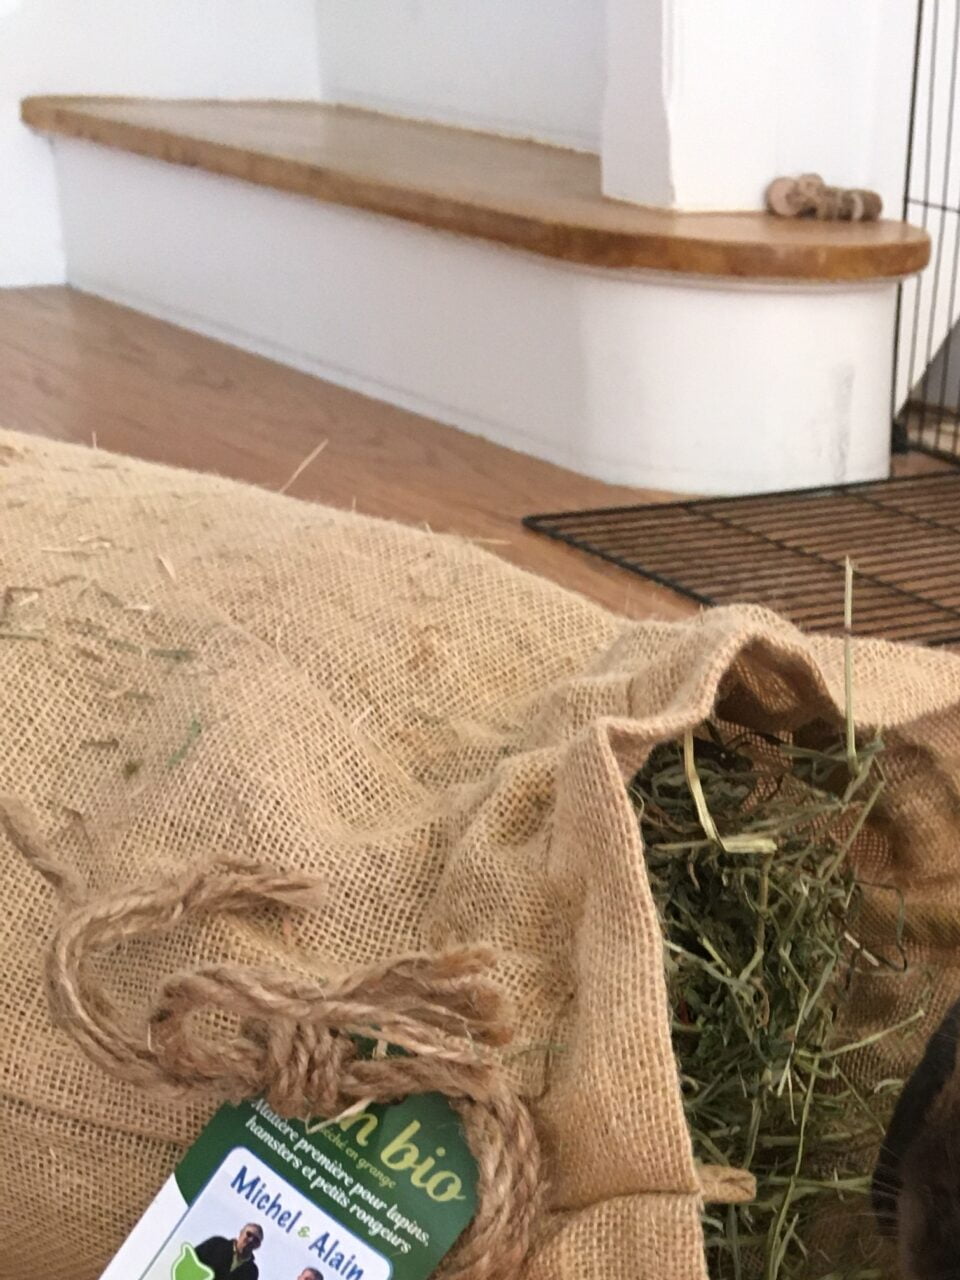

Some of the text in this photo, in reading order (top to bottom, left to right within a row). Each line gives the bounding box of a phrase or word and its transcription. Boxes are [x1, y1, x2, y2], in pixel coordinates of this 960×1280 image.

[244, 1115, 303, 1168] hamsters
[300, 1163, 318, 1180] et
[309, 1173, 352, 1208] petits
[348, 1204, 413, 1254] rongeurs
[293, 1137, 353, 1187] première
[347, 1182, 387, 1211] pour
[385, 1204, 431, 1246] lapins,
[344, 1145, 360, 1161] en
[355, 1157, 396, 1188] grange
[380, 1118, 466, 1200] bio
[229, 1164, 303, 1233] Michel
[297, 1225, 309, 1237] &
